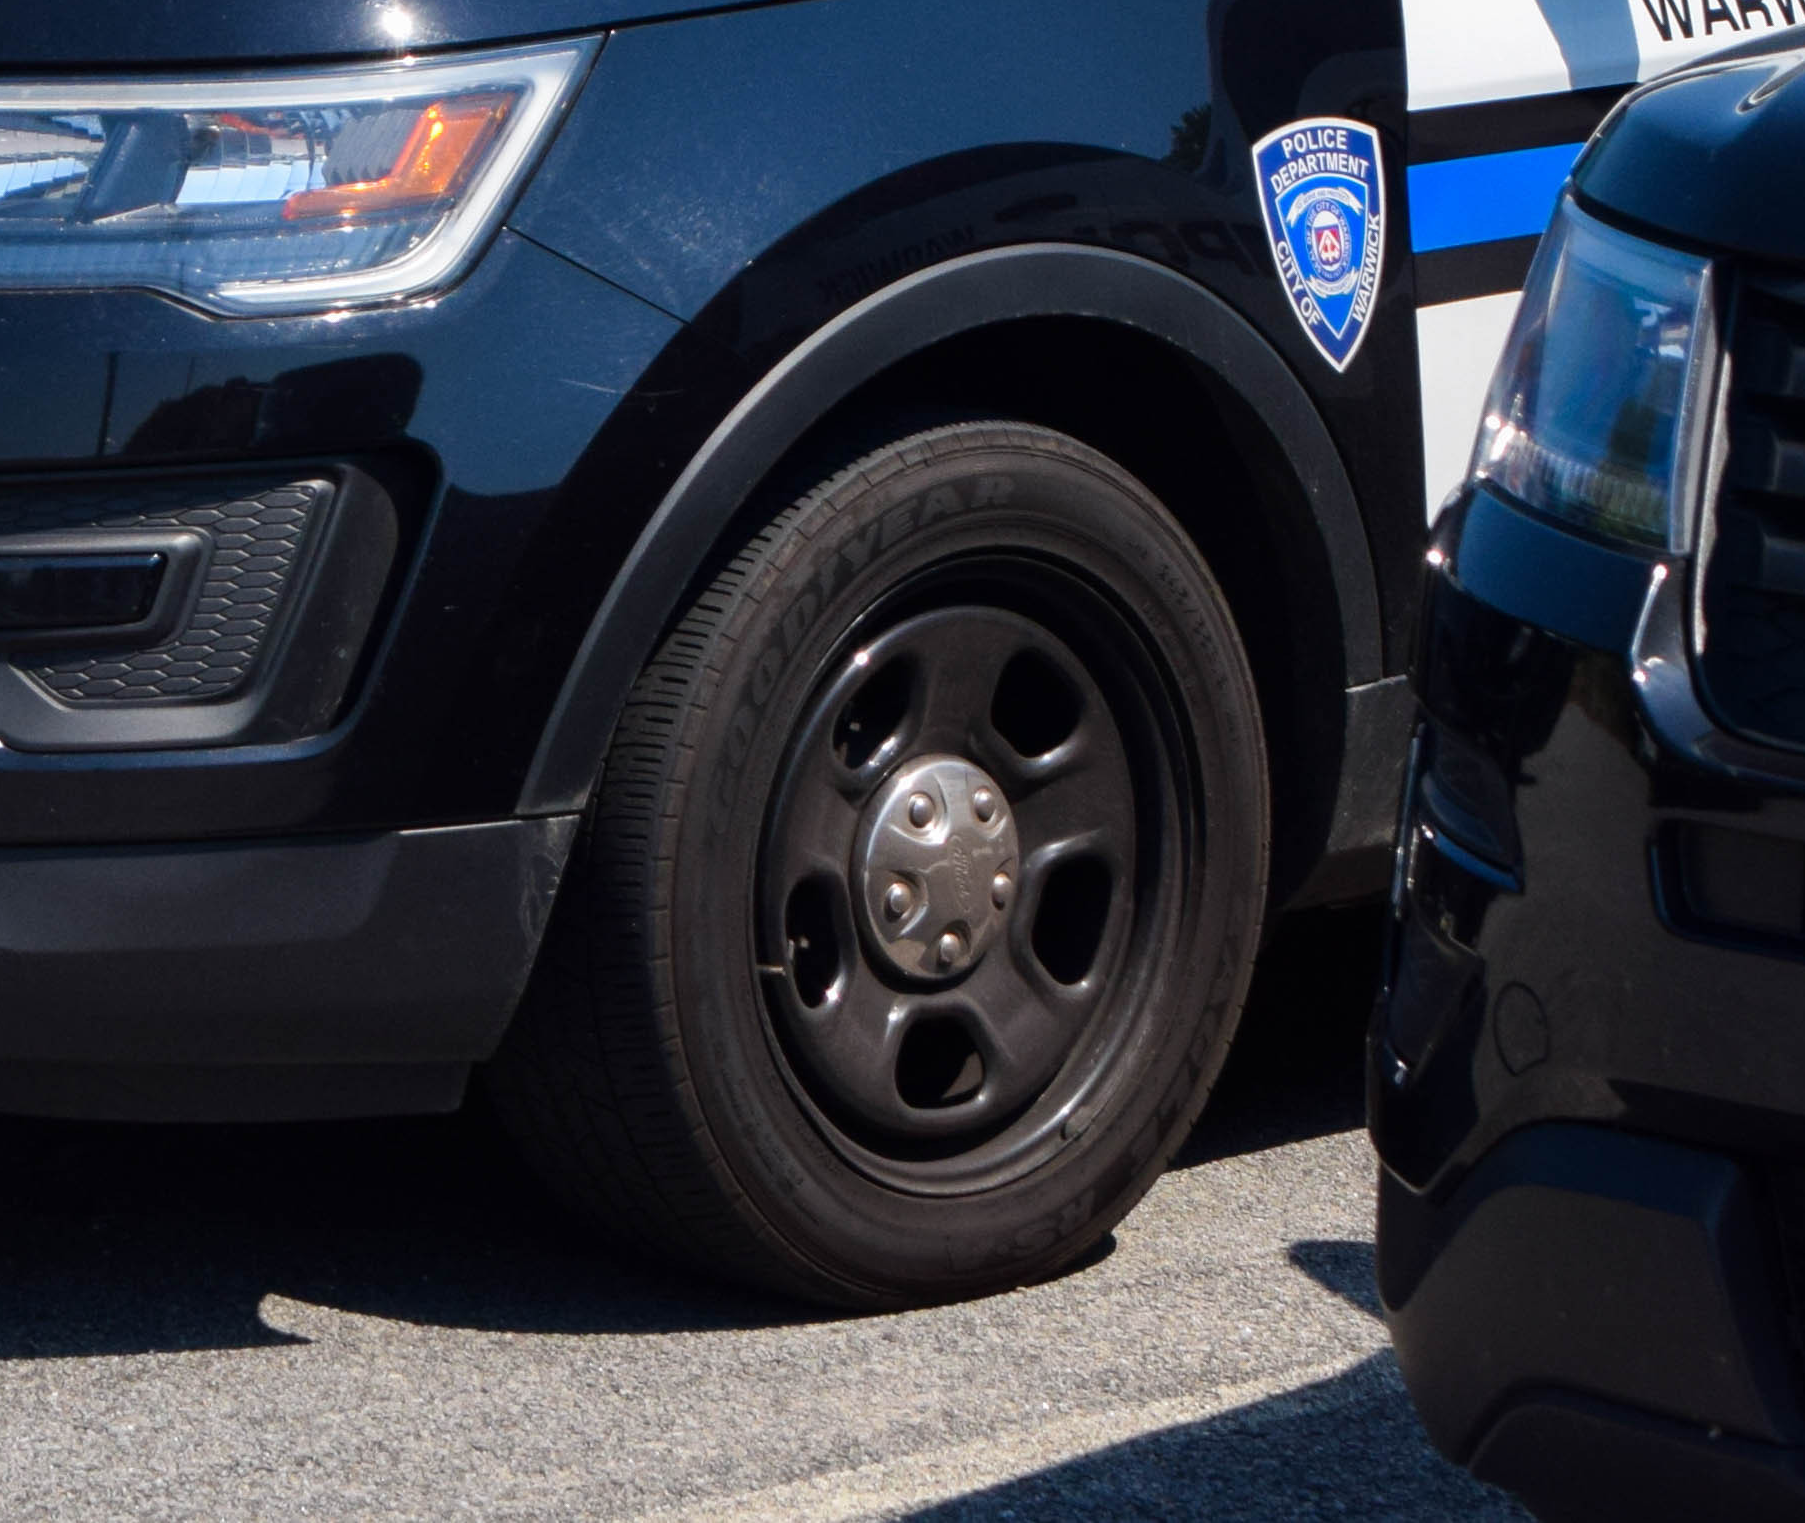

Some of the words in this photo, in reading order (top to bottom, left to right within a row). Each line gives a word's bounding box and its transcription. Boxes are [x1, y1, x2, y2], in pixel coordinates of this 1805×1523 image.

[1270, 151, 1370, 195] DEPARTMENT
[1281, 128, 1348, 160] POLICE
[1275, 239, 1306, 294] CITY
[1300, 294, 1322, 327] OF
[1351, 212, 1381, 325] WARWICK
